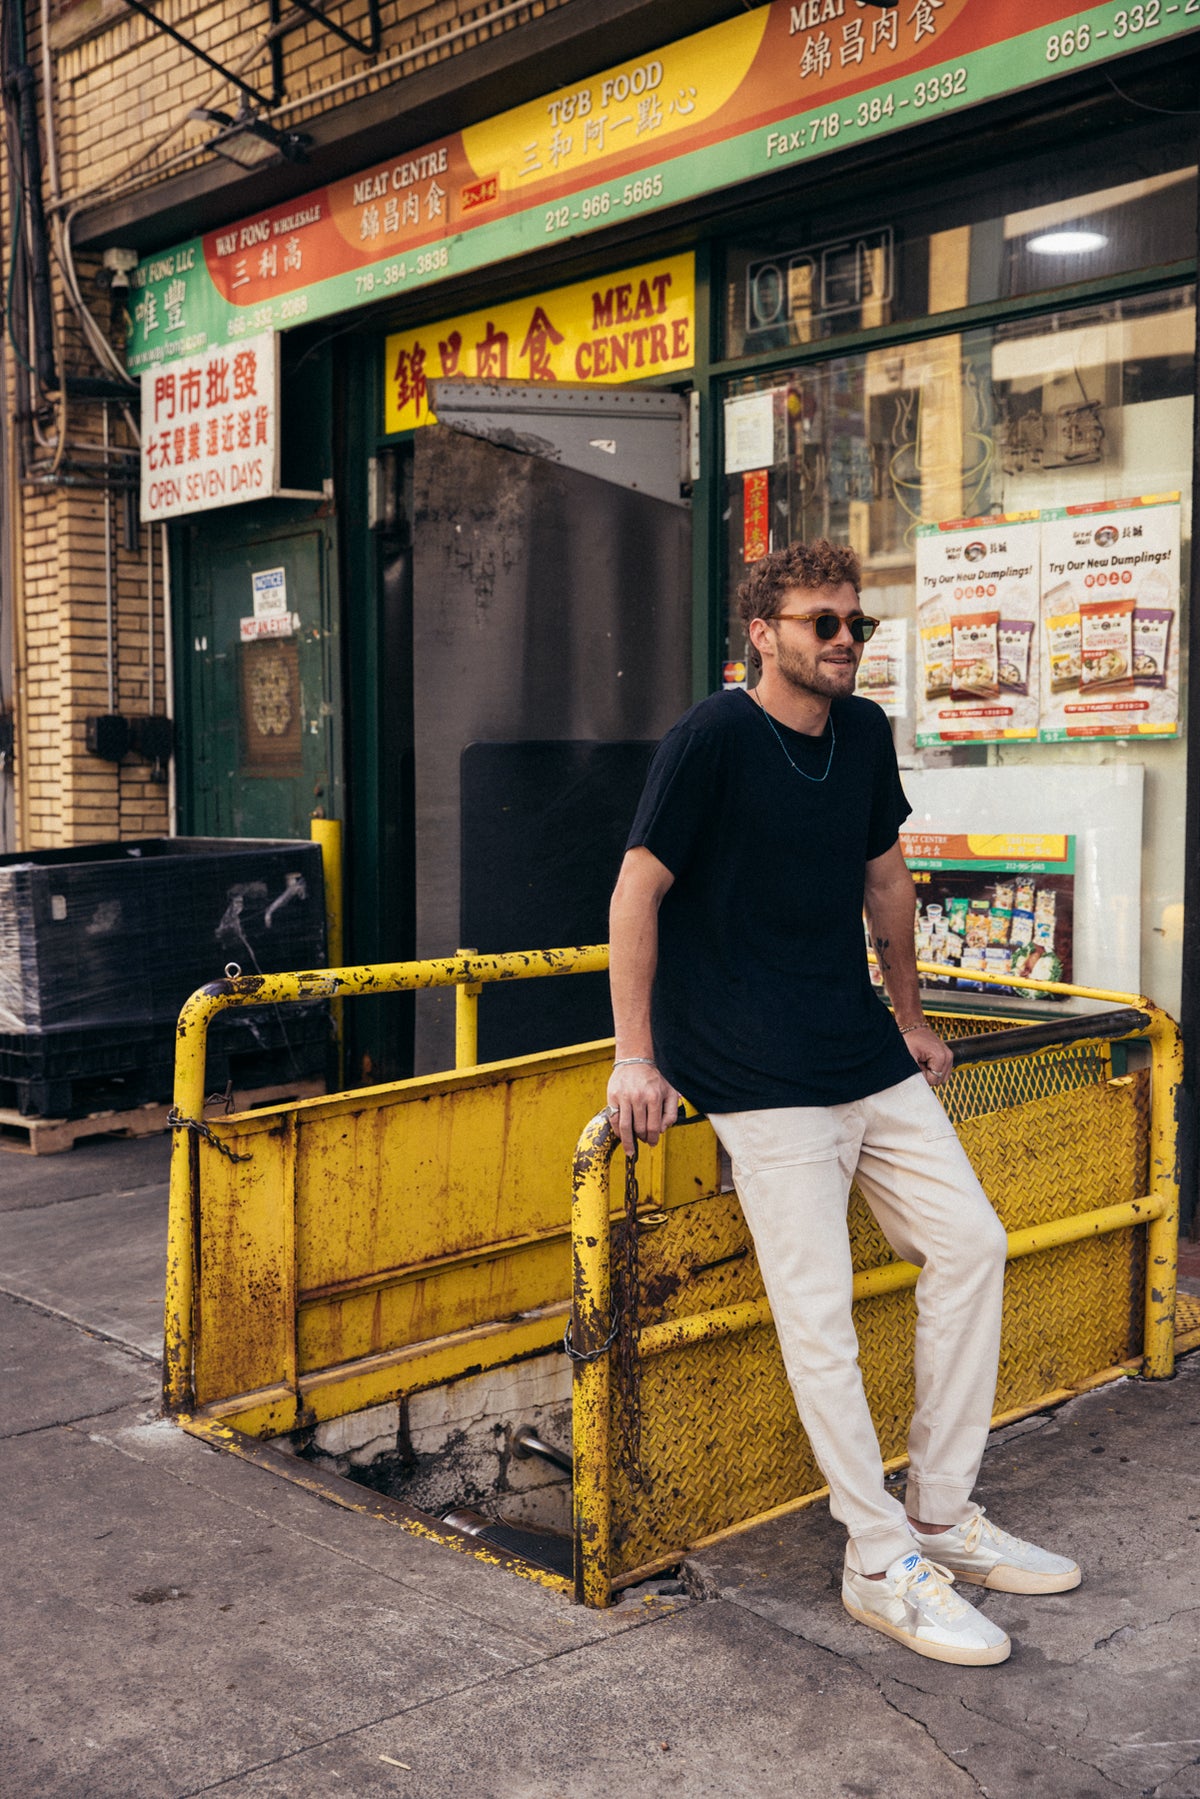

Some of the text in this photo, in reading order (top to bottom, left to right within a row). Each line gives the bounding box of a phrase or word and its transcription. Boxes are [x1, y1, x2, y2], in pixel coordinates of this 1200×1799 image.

[800, 0, 944, 78] 錦昌肉食
[547, 60, 663, 127] T&B FOOD
[519, 86, 698, 177] 三和阿一點心
[353, 148, 448, 206] MEAT CENTRE
[216, 204, 320, 257] WAY FONG WHOLESALE
[360, 180, 446, 240] 錦昌肉食
[148, 256, 174, 283] FONG
[176, 248, 195, 272] LLC
[232, 236, 302, 288] 三利高
[753, 234, 886, 323] OPEN
[591, 272, 672, 331] MEAT
[574, 317, 689, 380] CENTRE
[155, 350, 257, 424] 門市批發
[149, 458, 263, 509] OPEN SEVEN DAYS
[923, 565, 1033, 588] Try Our New Dumplings!
[1049, 549, 1171, 575] Try Our New Dumplings!
[242, 621, 256, 636] NOT
